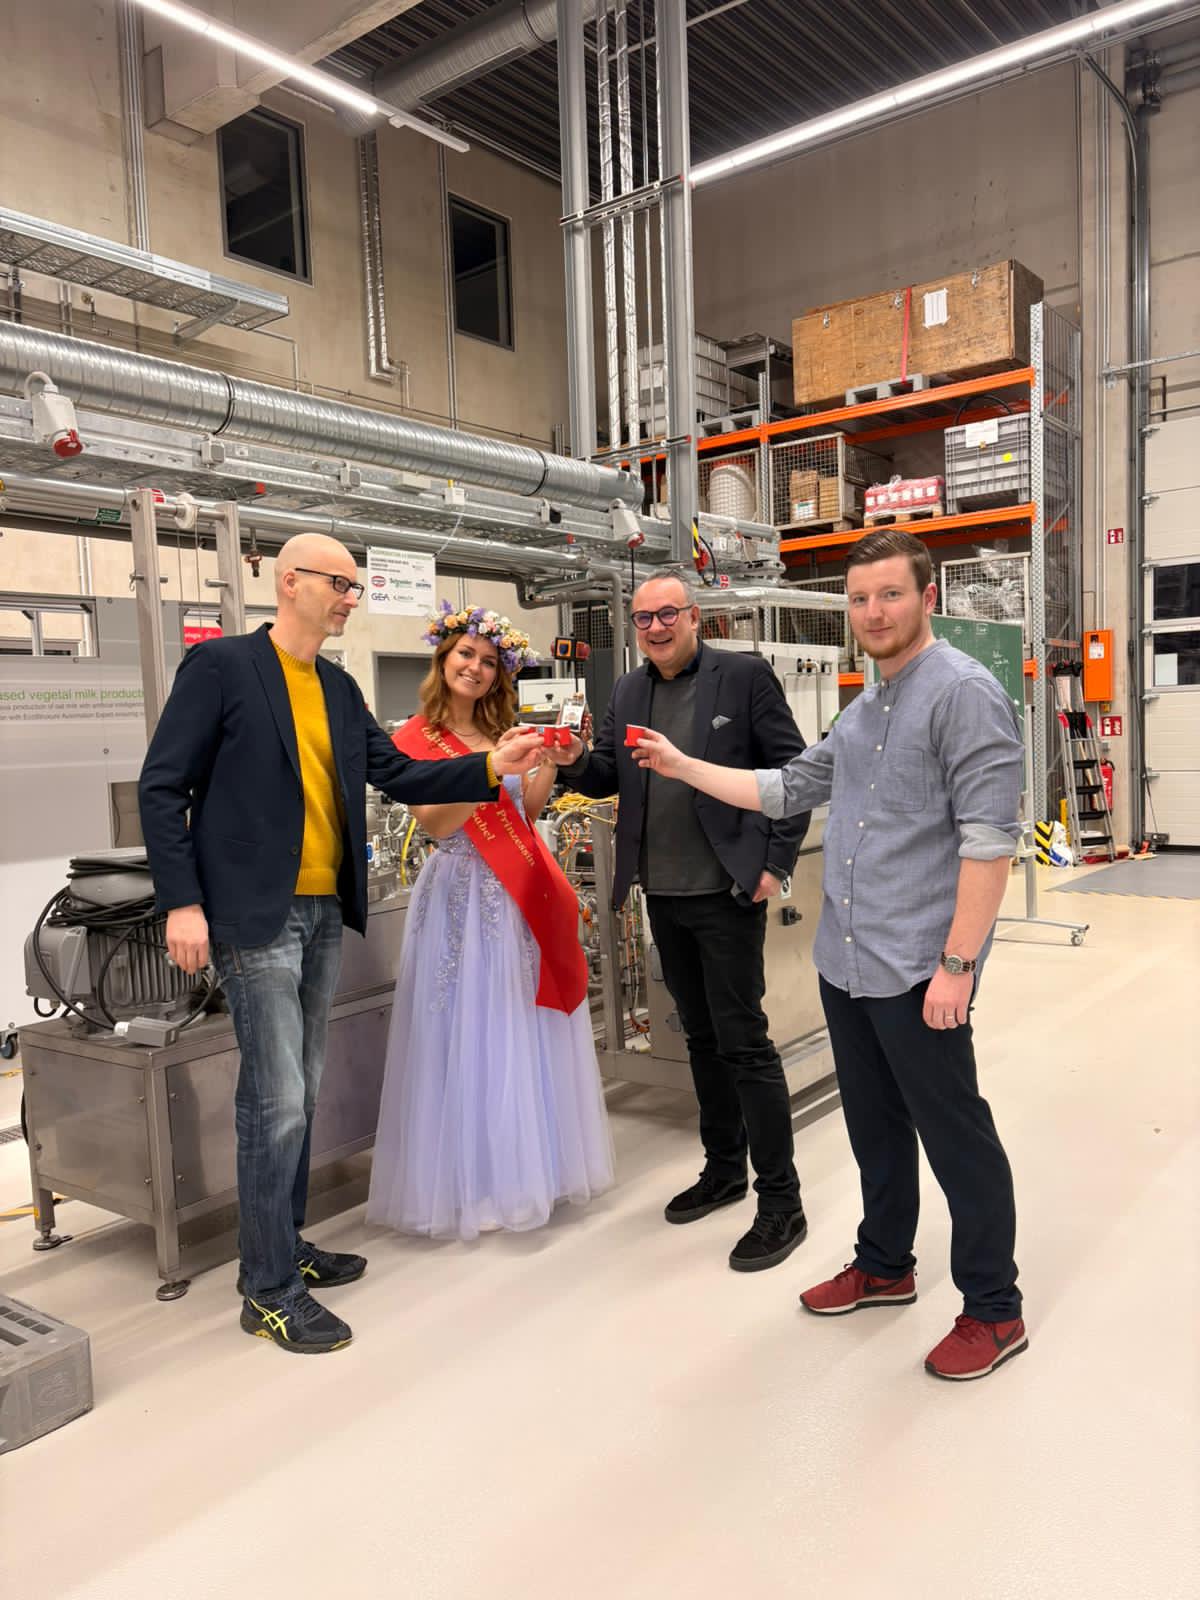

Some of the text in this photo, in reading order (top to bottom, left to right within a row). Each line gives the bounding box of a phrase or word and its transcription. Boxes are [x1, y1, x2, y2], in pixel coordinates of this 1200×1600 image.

[371, 592, 390, 602] GEA
[30, 688, 72, 702] vegetal
[74, 688, 97, 699] milk
[100, 687, 144, 701] product
[496, 809, 536, 867] Prinzessin
